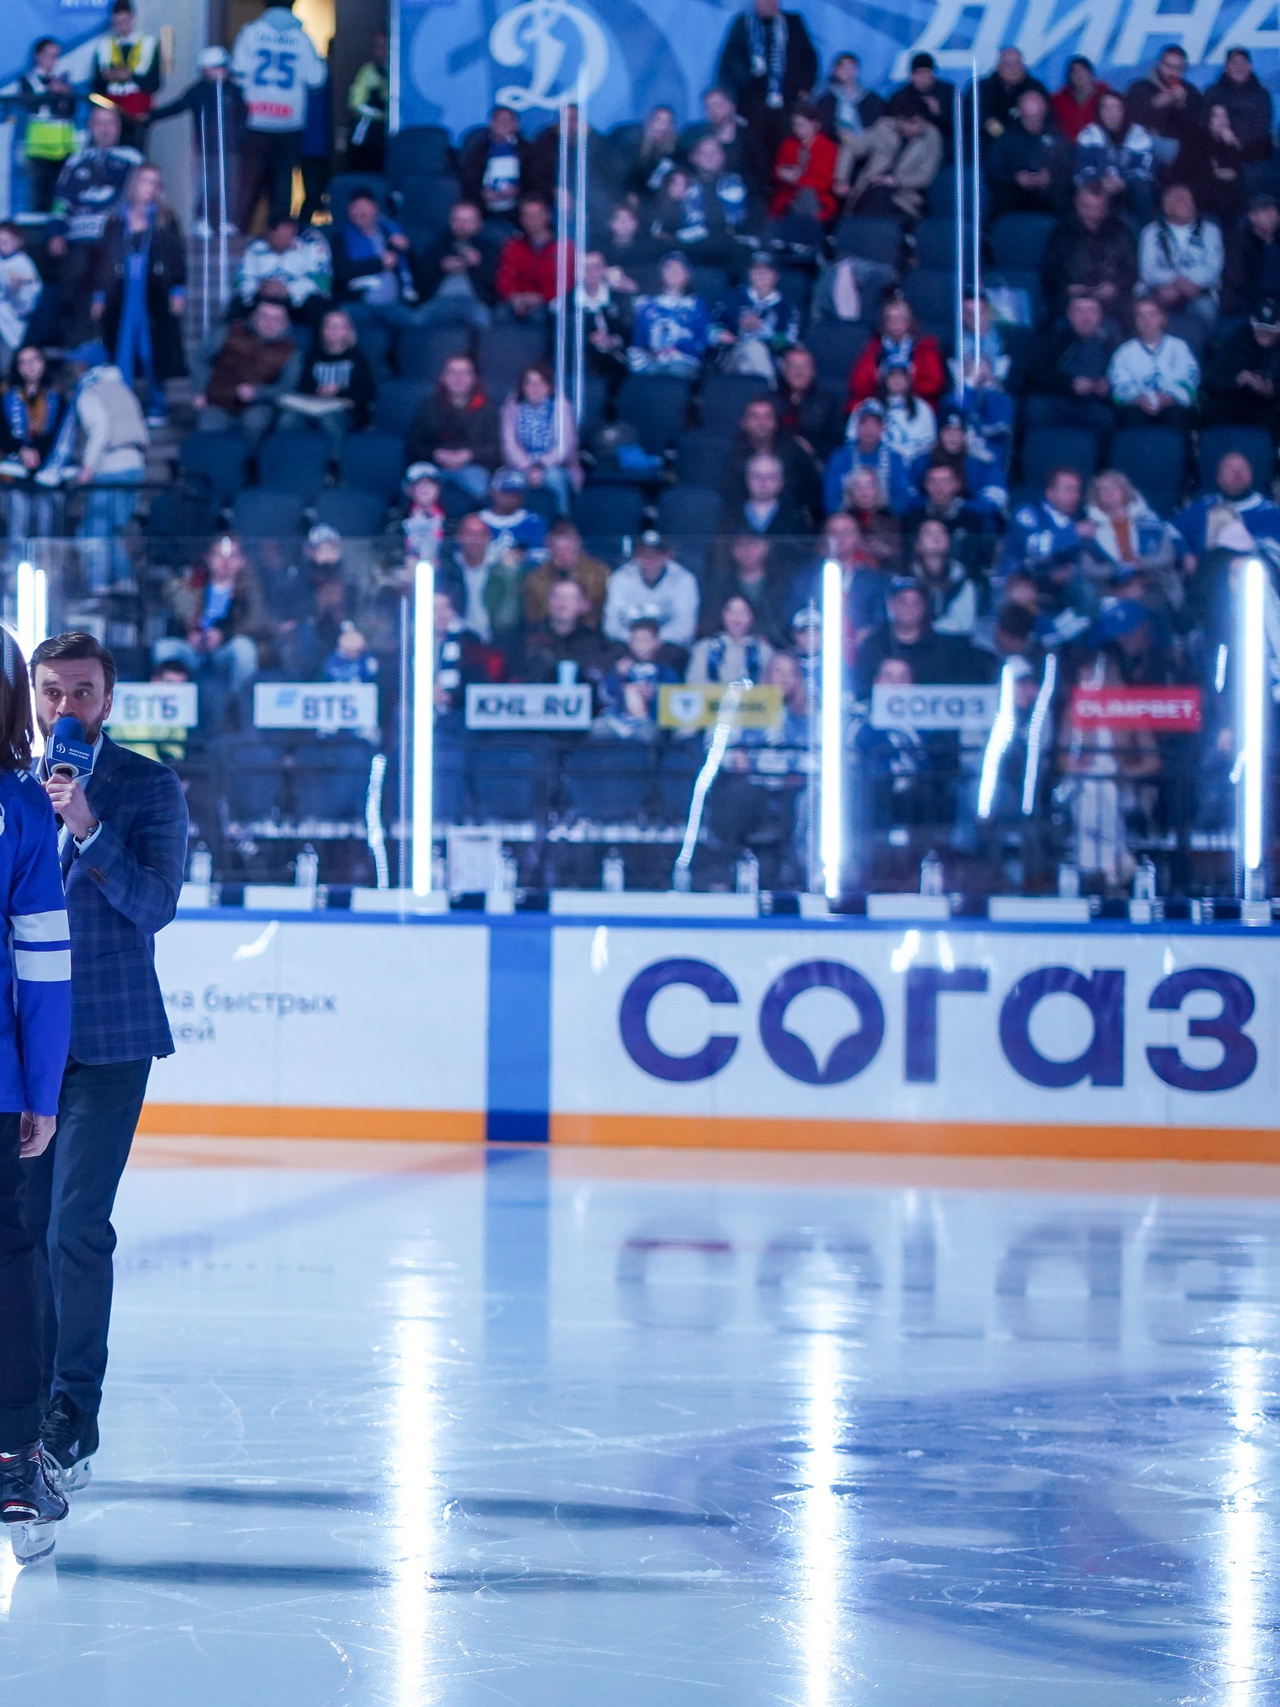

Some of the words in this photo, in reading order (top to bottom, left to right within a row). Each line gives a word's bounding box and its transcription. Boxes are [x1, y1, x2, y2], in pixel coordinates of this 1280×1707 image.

[253, 48, 297, 89] 25
[123, 694, 179, 720] ВТБ
[303, 695, 357, 721] ВТБ
[202, 984, 337, 1018] быстрых
[618, 956, 1258, 1092] согаз
